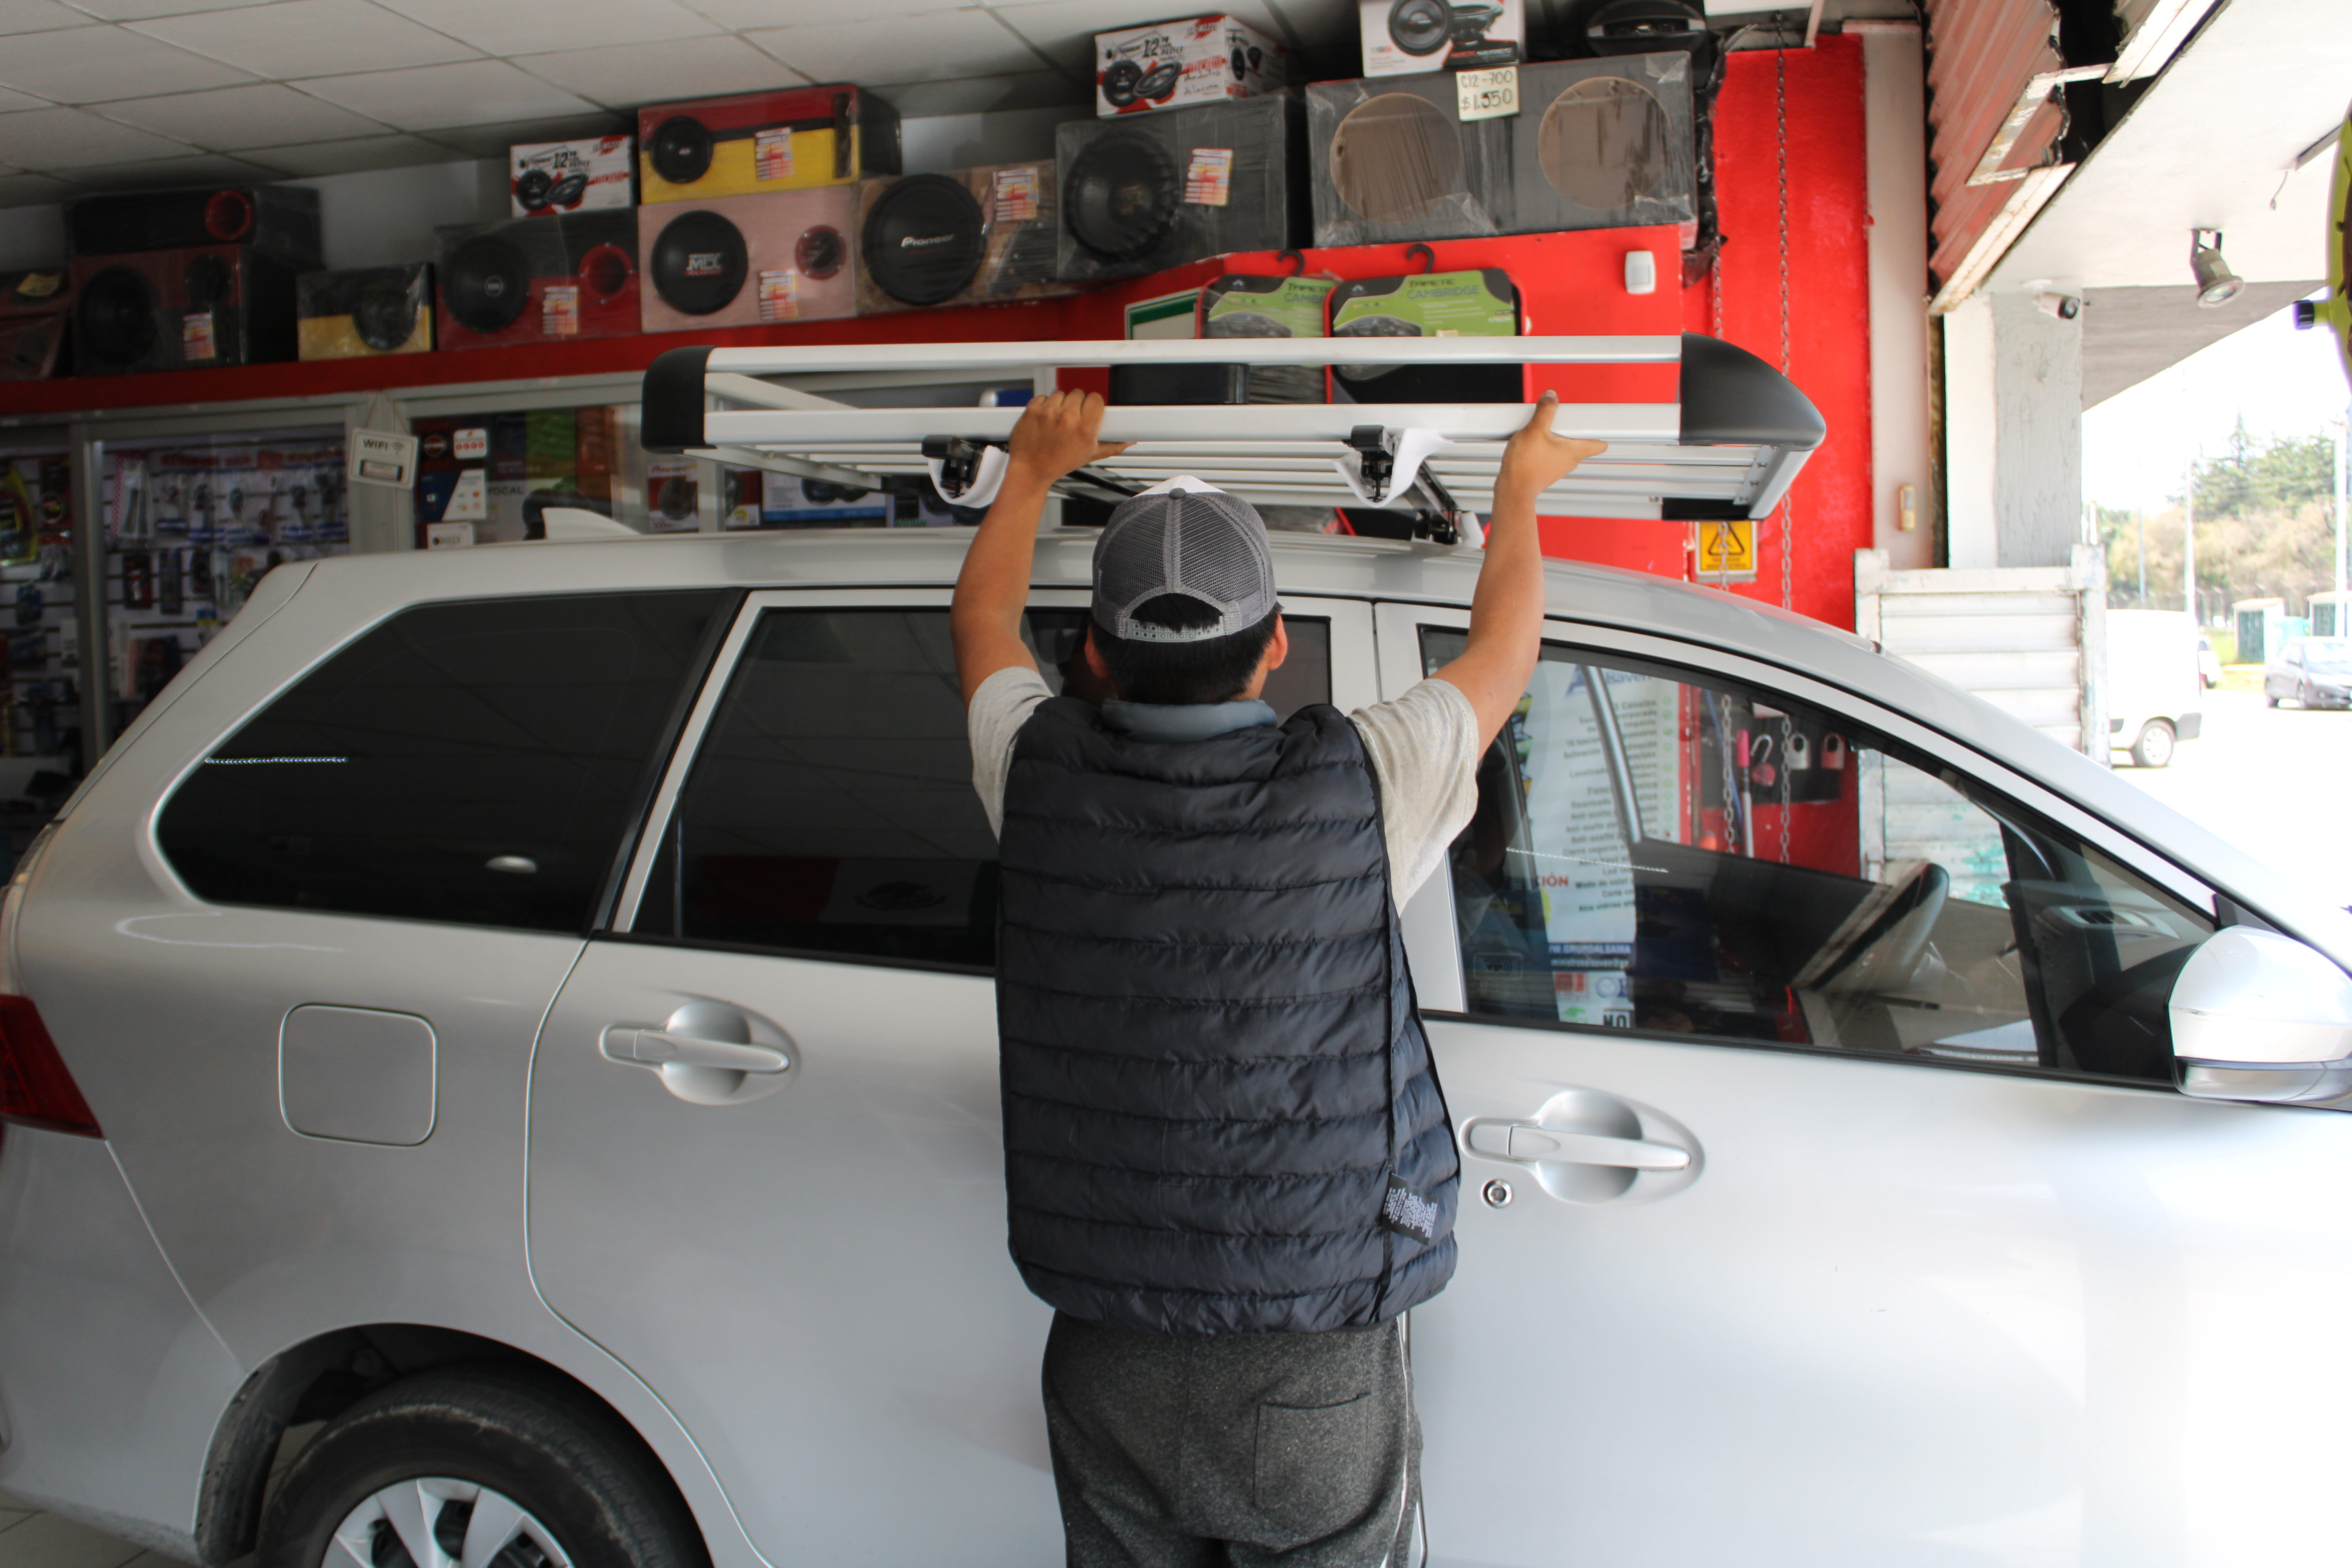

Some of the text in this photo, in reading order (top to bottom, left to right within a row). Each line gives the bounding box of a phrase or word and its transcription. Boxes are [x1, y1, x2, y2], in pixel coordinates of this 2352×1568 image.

[901, 234, 955, 248] Pioneer
[686, 252, 722, 270] MTX
[1409, 278, 1454, 288] TAPETE
[1406, 285, 1480, 299] CAMBRIDGE
[363, 438, 388, 451] WIFI
